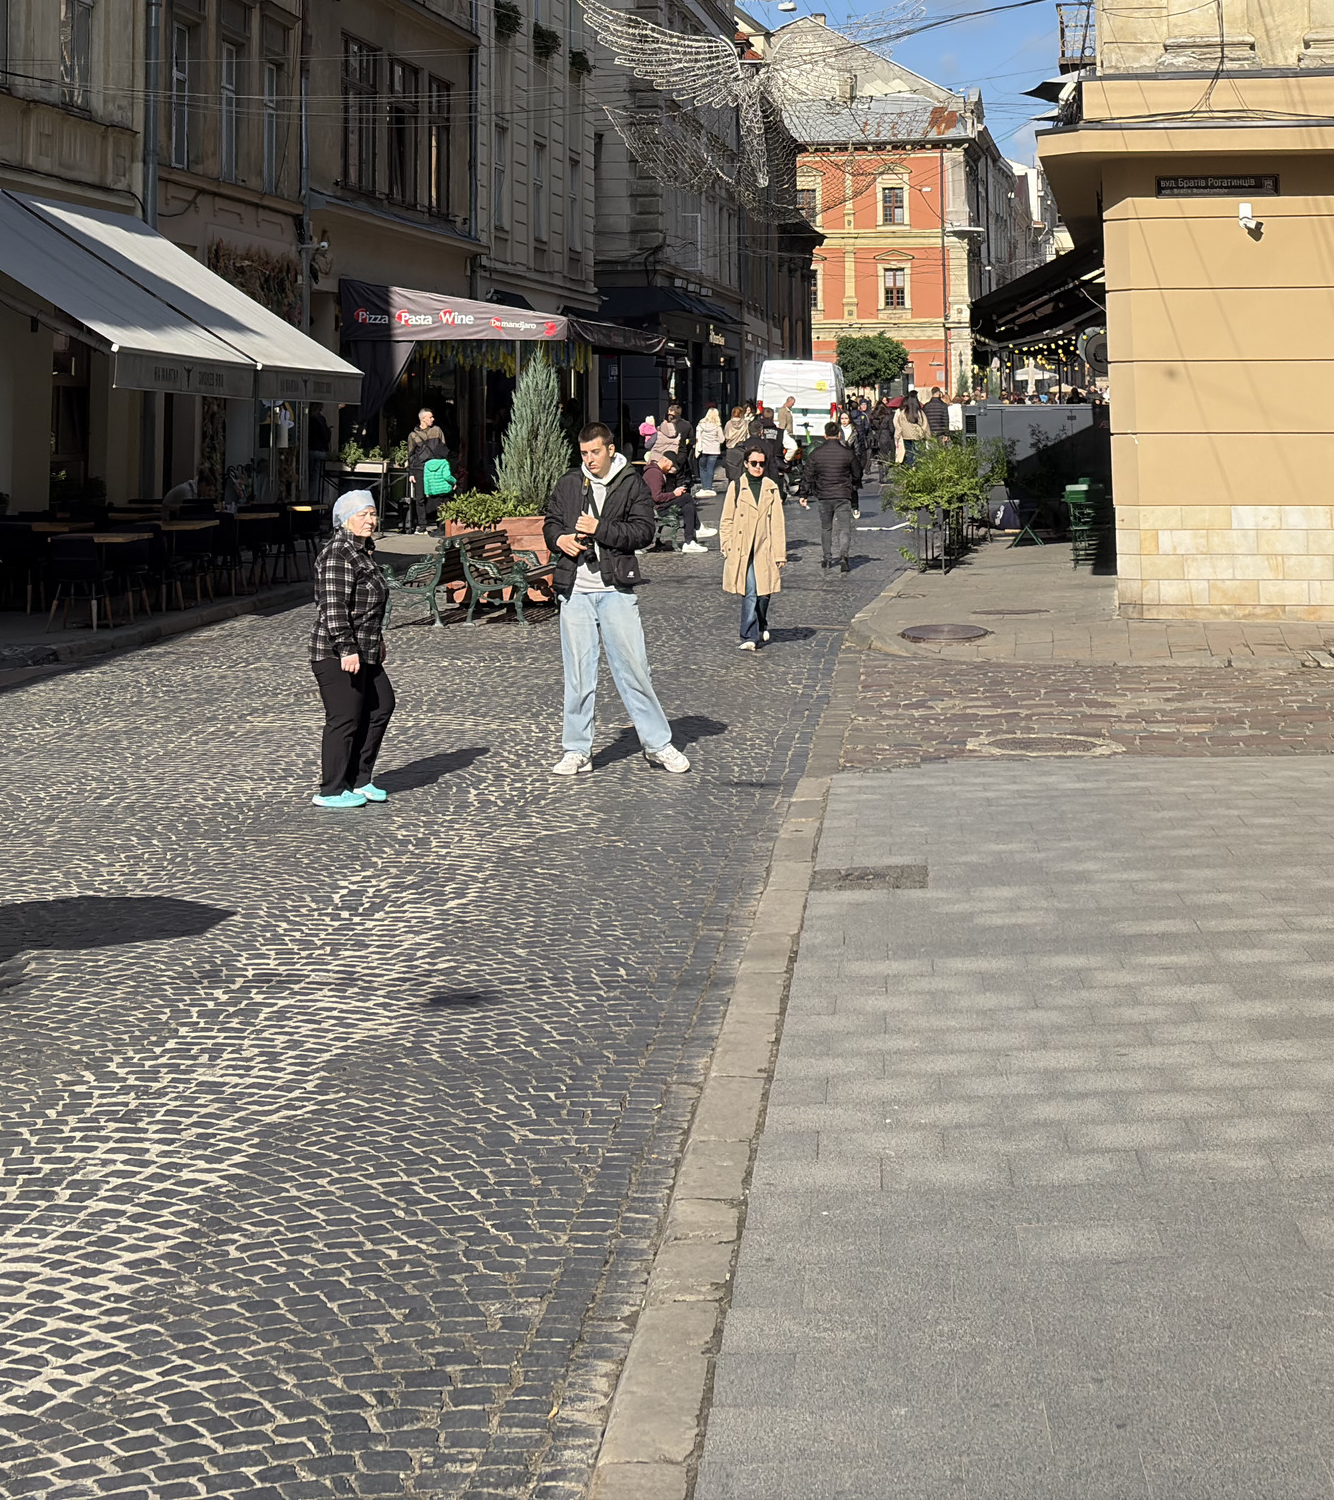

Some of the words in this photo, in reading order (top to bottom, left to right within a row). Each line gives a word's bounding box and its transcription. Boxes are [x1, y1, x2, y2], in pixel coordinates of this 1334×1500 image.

[1160, 180, 1176, 188] вул.
[1178, 178, 1206, 188] Братів
[1208, 177, 1256, 188] Рогатинців
[358, 311, 389, 324] Pizza
[400, 312, 433, 325] Pasta
[440, 311, 475, 325] Wine
